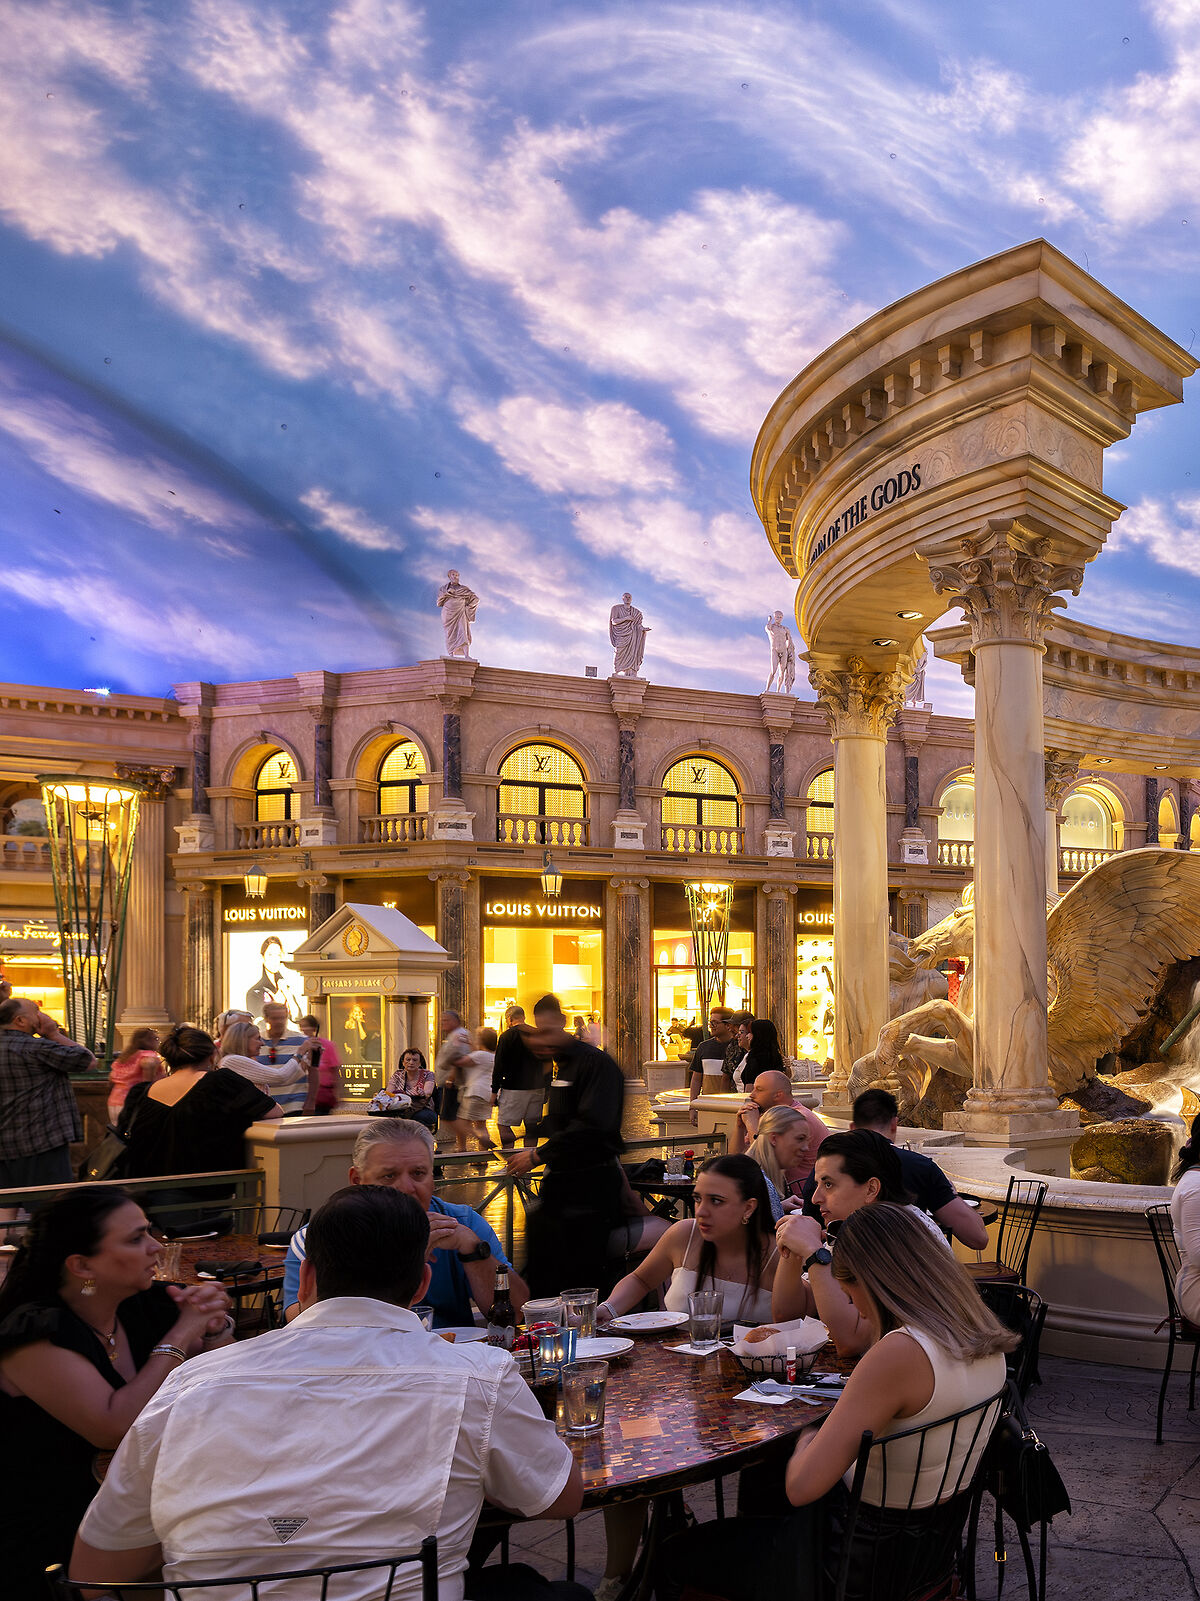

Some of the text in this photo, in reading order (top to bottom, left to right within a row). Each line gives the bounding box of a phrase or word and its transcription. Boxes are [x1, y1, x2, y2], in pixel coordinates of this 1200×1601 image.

[827, 517, 841, 547] OF
[841, 494, 868, 534] THE
[870, 463, 921, 511] GODS
[224, 907, 306, 921] LOUIS VUITTON
[486, 903, 601, 918] LOUIS VUITTON
[799, 912, 835, 924] LOUIS
[322, 979, 381, 987] CAESARS PALACE
